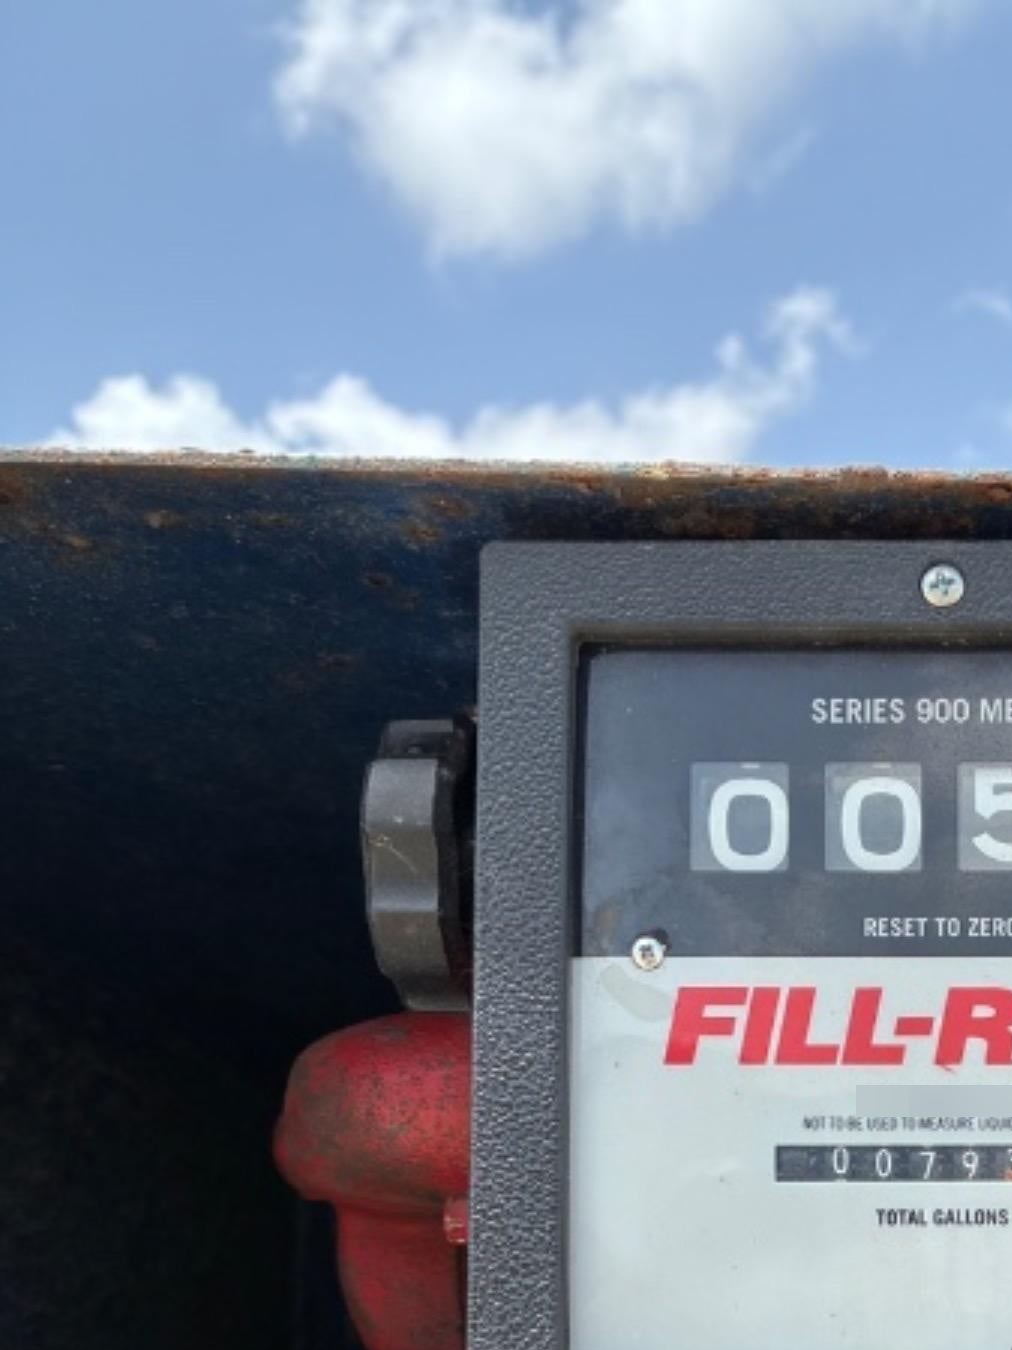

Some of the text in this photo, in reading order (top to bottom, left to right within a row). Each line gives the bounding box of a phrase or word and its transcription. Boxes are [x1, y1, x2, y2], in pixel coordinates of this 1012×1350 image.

[811, 698, 905, 724] SERIES
[916, 698, 970, 724] 900
[864, 917, 928, 937] RESET
[935, 917, 961, 937] TO
[803, 1116, 826, 1131] NOT
[829, 1116, 844, 1131] TO
[866, 1116, 898, 1131] USED
[902, 1116, 915, 1131] TO
[917, 1116, 976, 1131] MEASURE
[876, 1208, 1009, 1226] TOTAL GALLONS
